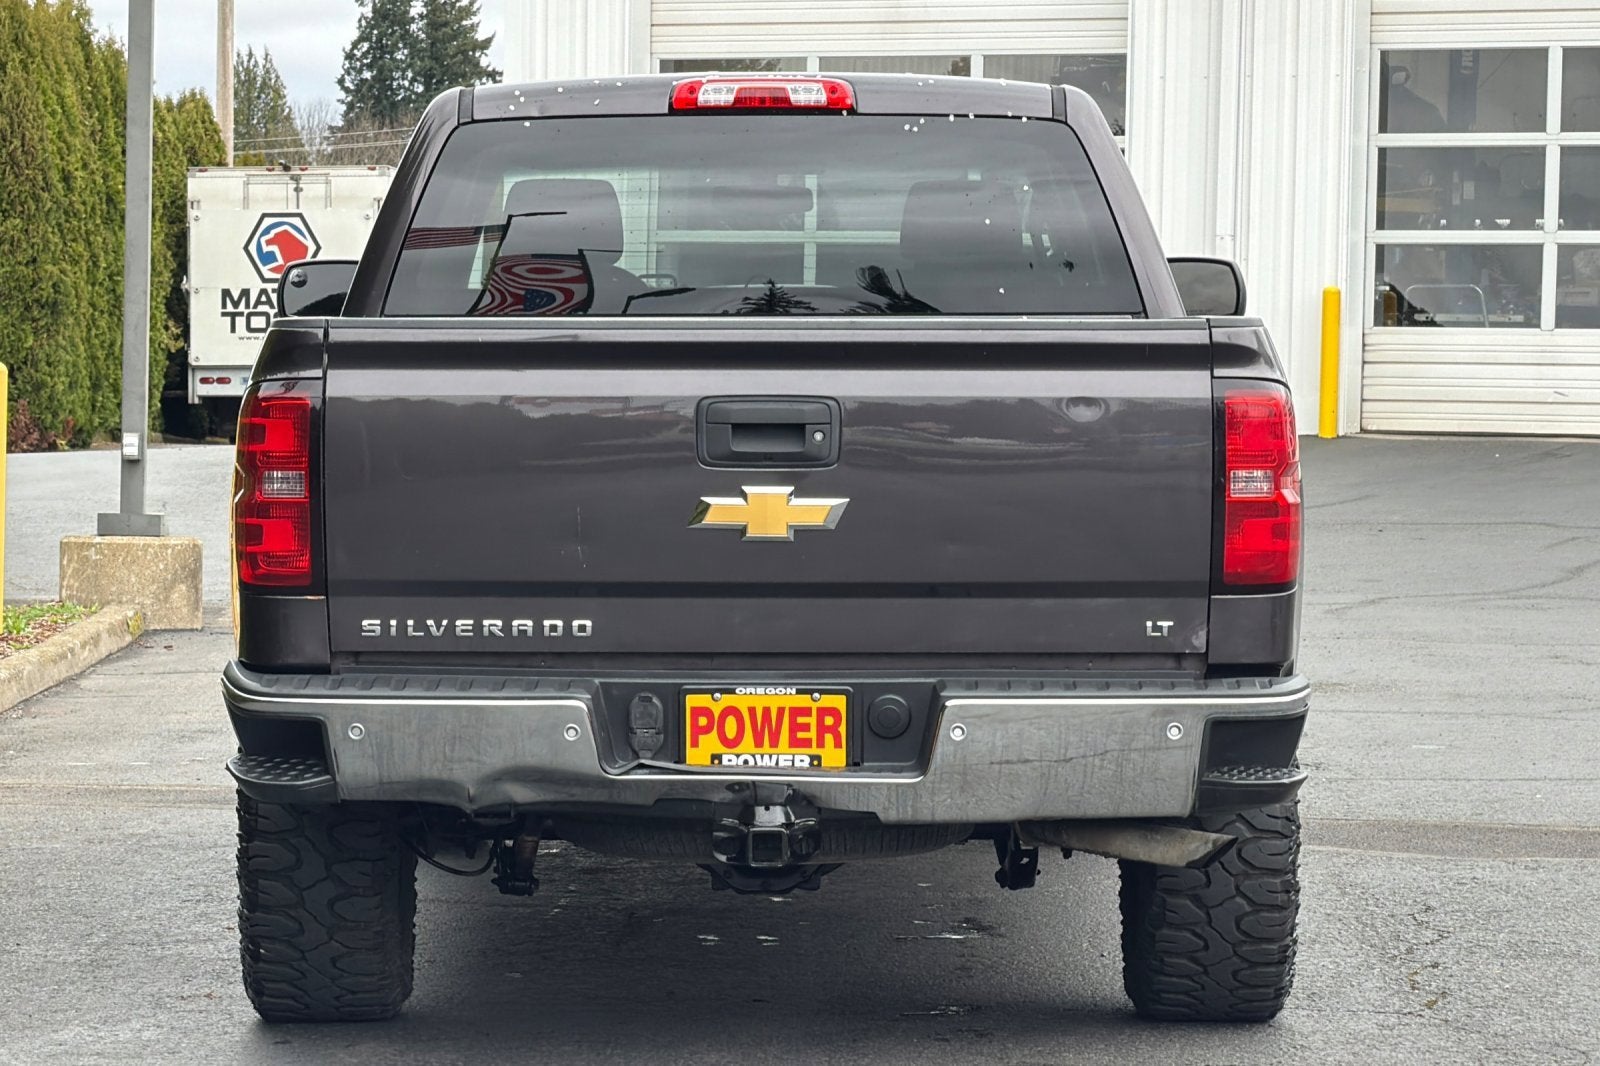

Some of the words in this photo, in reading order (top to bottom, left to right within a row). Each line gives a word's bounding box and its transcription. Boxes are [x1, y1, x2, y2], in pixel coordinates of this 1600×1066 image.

[221, 288, 277, 309] MA
[221, 311, 278, 333] TO
[361, 619, 593, 637] SILVERADO
[1146, 621, 1174, 637] LT
[735, 687, 797, 695] OREGON
[690, 705, 843, 749] POWER
